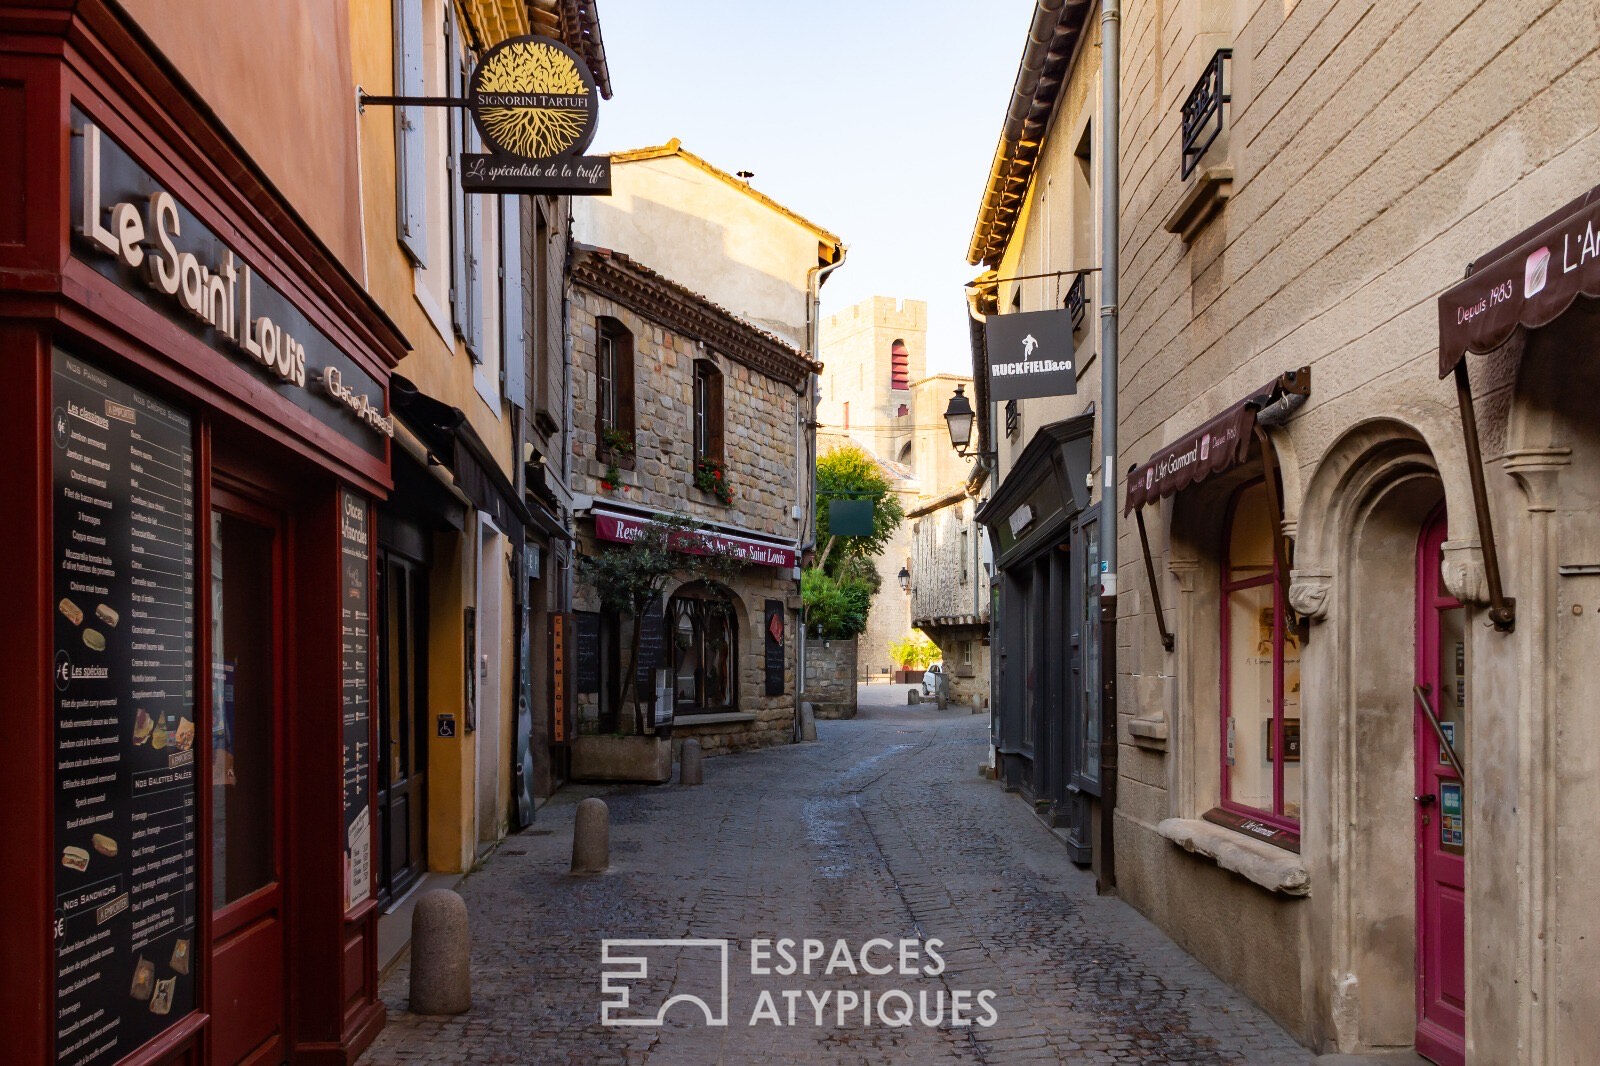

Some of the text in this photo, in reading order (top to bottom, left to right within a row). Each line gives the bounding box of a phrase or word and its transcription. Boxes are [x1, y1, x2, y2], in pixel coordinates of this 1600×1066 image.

[478, 94, 588, 108] SIGNORINI TARTUFI
[465, 158, 487, 181] Le
[545, 163, 557, 177] de
[561, 163, 572, 178] la
[577, 163, 605, 184] truffe
[84, 124, 305, 387] Le Saint Louis
[1457, 279, 1513, 325] Depuis 1983
[555, 618, 563, 739] CERAMIQUES
